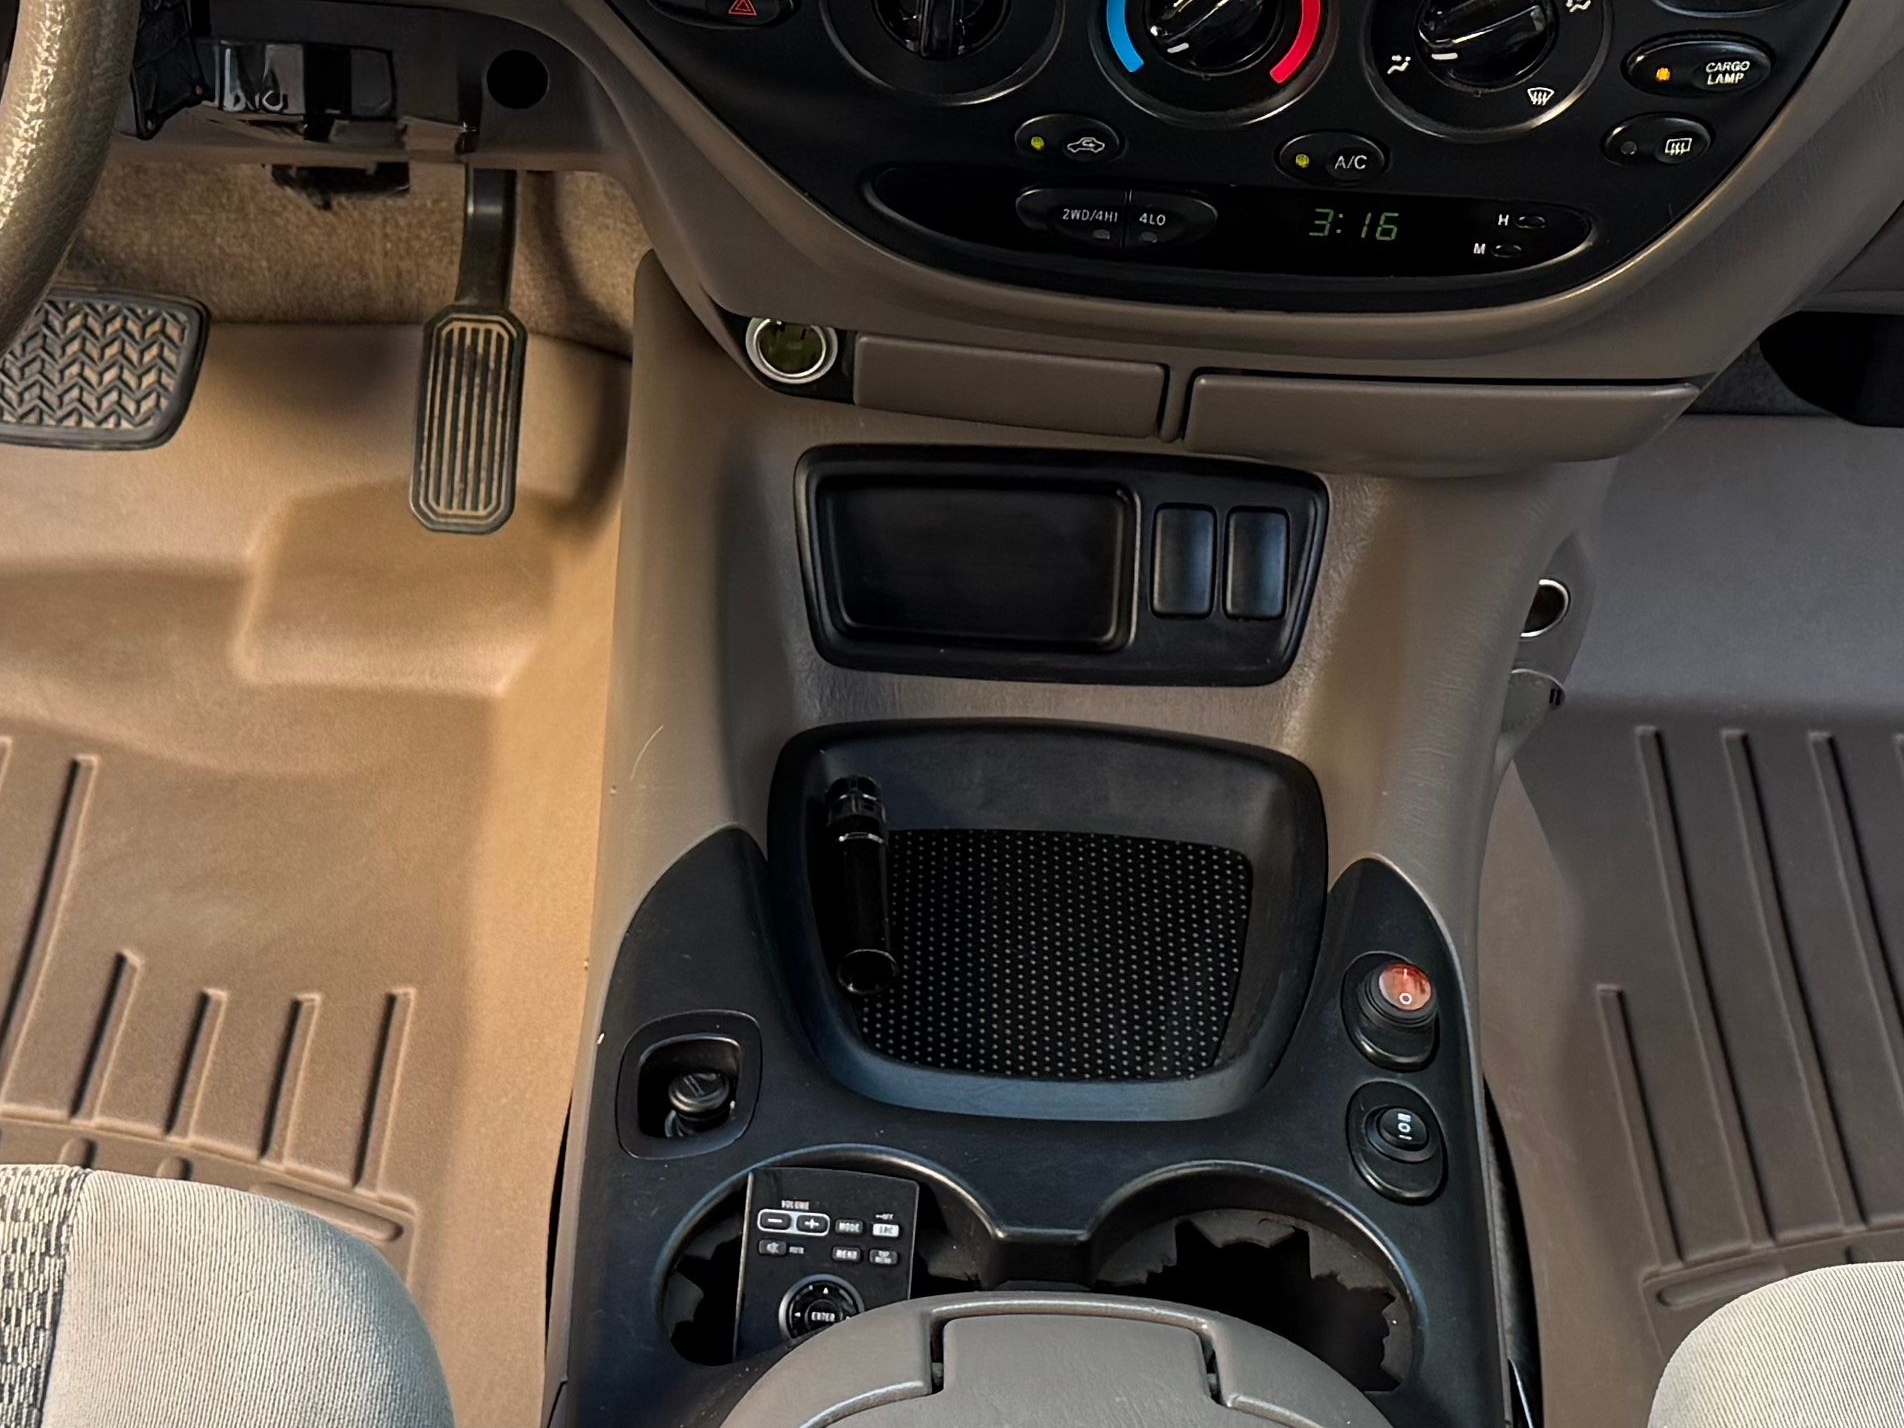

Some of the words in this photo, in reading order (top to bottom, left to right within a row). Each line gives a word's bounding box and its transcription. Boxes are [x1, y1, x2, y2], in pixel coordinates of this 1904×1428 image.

[1705, 60, 1751, 73] CARGO
[1707, 72, 1745, 86] LAMP
[1334, 154, 1369, 170] A/C
[1062, 208, 1118, 222] 2WD/4HI
[1139, 212, 1166, 226] 4LO
[1498, 213, 1510, 227] H
[1308, 208, 1399, 241] 3:16
[1473, 242, 1487, 255] M
